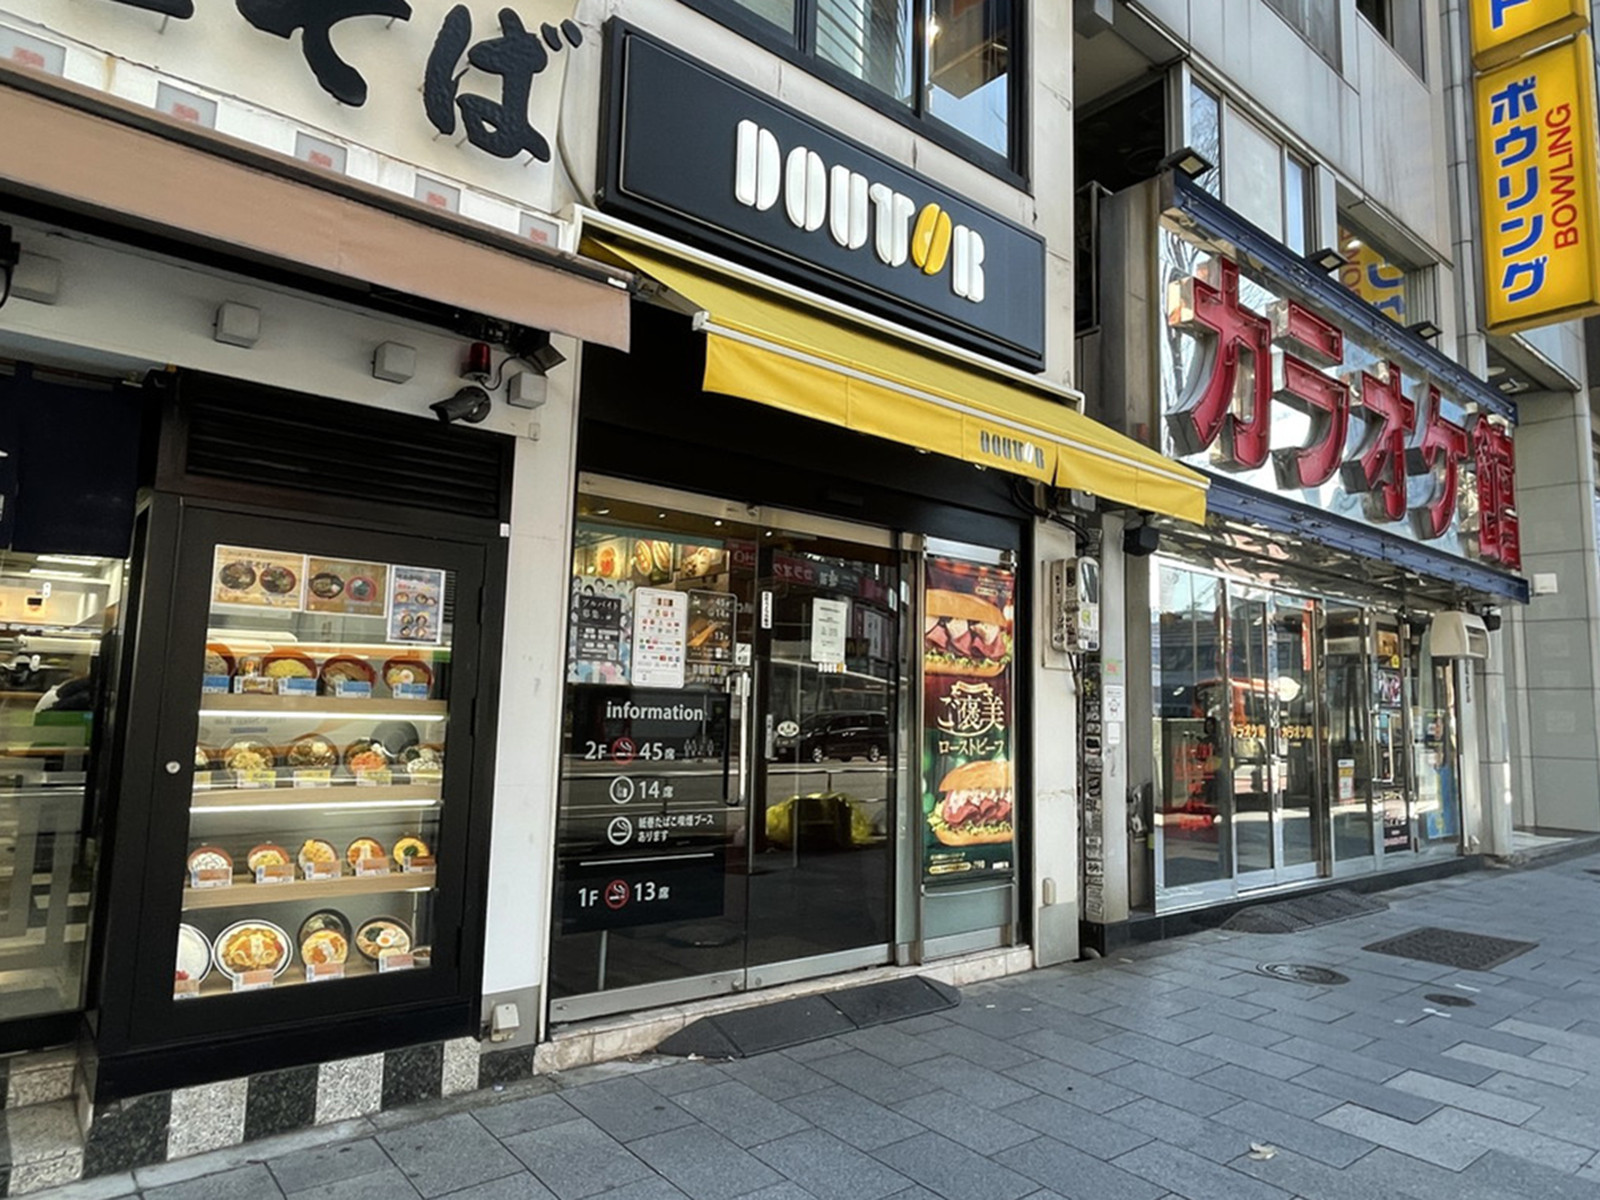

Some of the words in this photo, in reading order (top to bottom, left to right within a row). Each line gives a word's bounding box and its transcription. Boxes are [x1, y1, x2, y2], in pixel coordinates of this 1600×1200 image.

[1491, 76, 1547, 303] ボウリング
[1545, 103, 1579, 250] BOWLING
[735, 118, 985, 303] DOUTOR
[980, 430, 1045, 470] DOUTOR
[606, 701, 704, 721] information
[937, 694, 1005, 731] ご褒美
[584, 740, 608, 760] 2F
[938, 737, 1004, 756] ローストビーフ
[638, 830, 669, 842] あります
[578, 887, 599, 907] 1F
